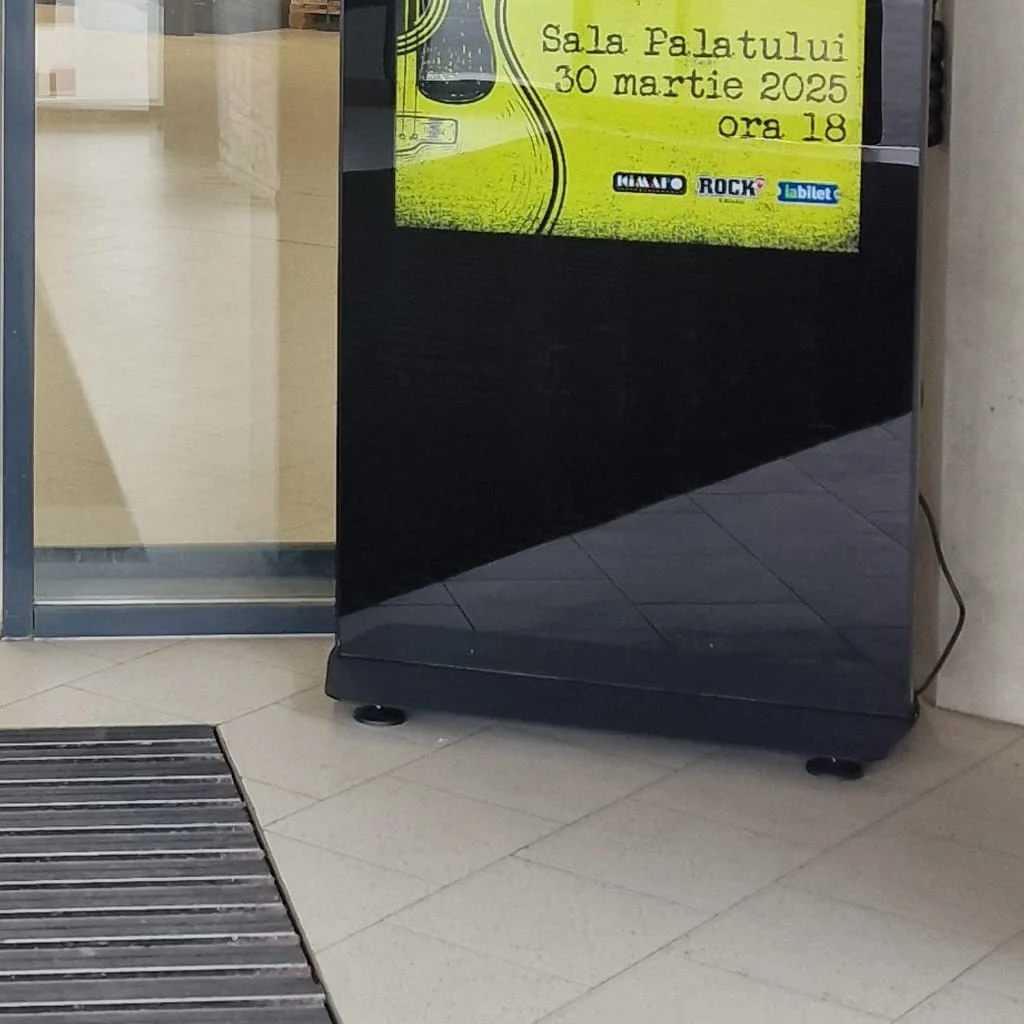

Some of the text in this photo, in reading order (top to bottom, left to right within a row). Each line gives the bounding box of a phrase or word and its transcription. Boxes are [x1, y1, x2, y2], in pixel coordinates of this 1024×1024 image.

[542, 23, 849, 62] Sala Palatului
[554, 65, 849, 104] 30 martie 2025
[718, 112, 847, 143] ora 18
[699, 177, 756, 196] ROCK
